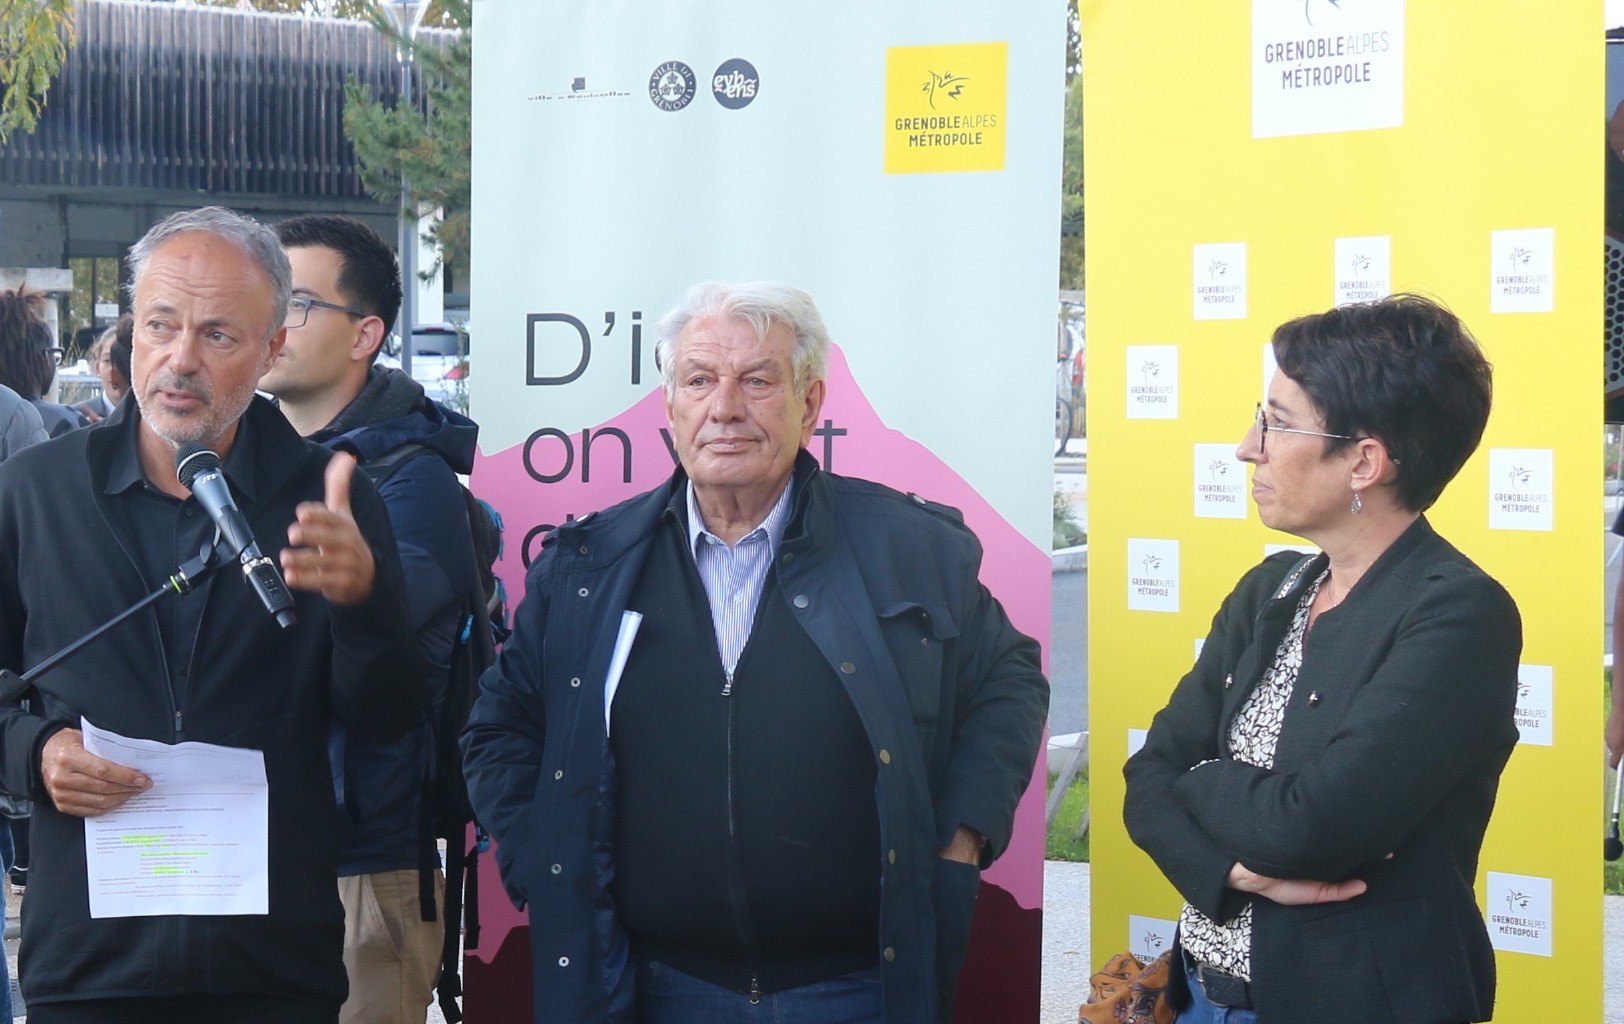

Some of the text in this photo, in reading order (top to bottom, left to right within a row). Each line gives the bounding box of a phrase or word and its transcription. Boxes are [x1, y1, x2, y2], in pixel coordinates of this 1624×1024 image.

[1282, 61, 1371, 90] MÉTROPOLE
[908, 131, 983, 147] MÉTROPOLE
[1503, 285, 1541, 295] MÉTROPOLE
[522, 427, 633, 483] on
[1501, 502, 1541, 513] MÉTROPOLE
[1499, 925, 1539, 938] MÉTROPOLE
